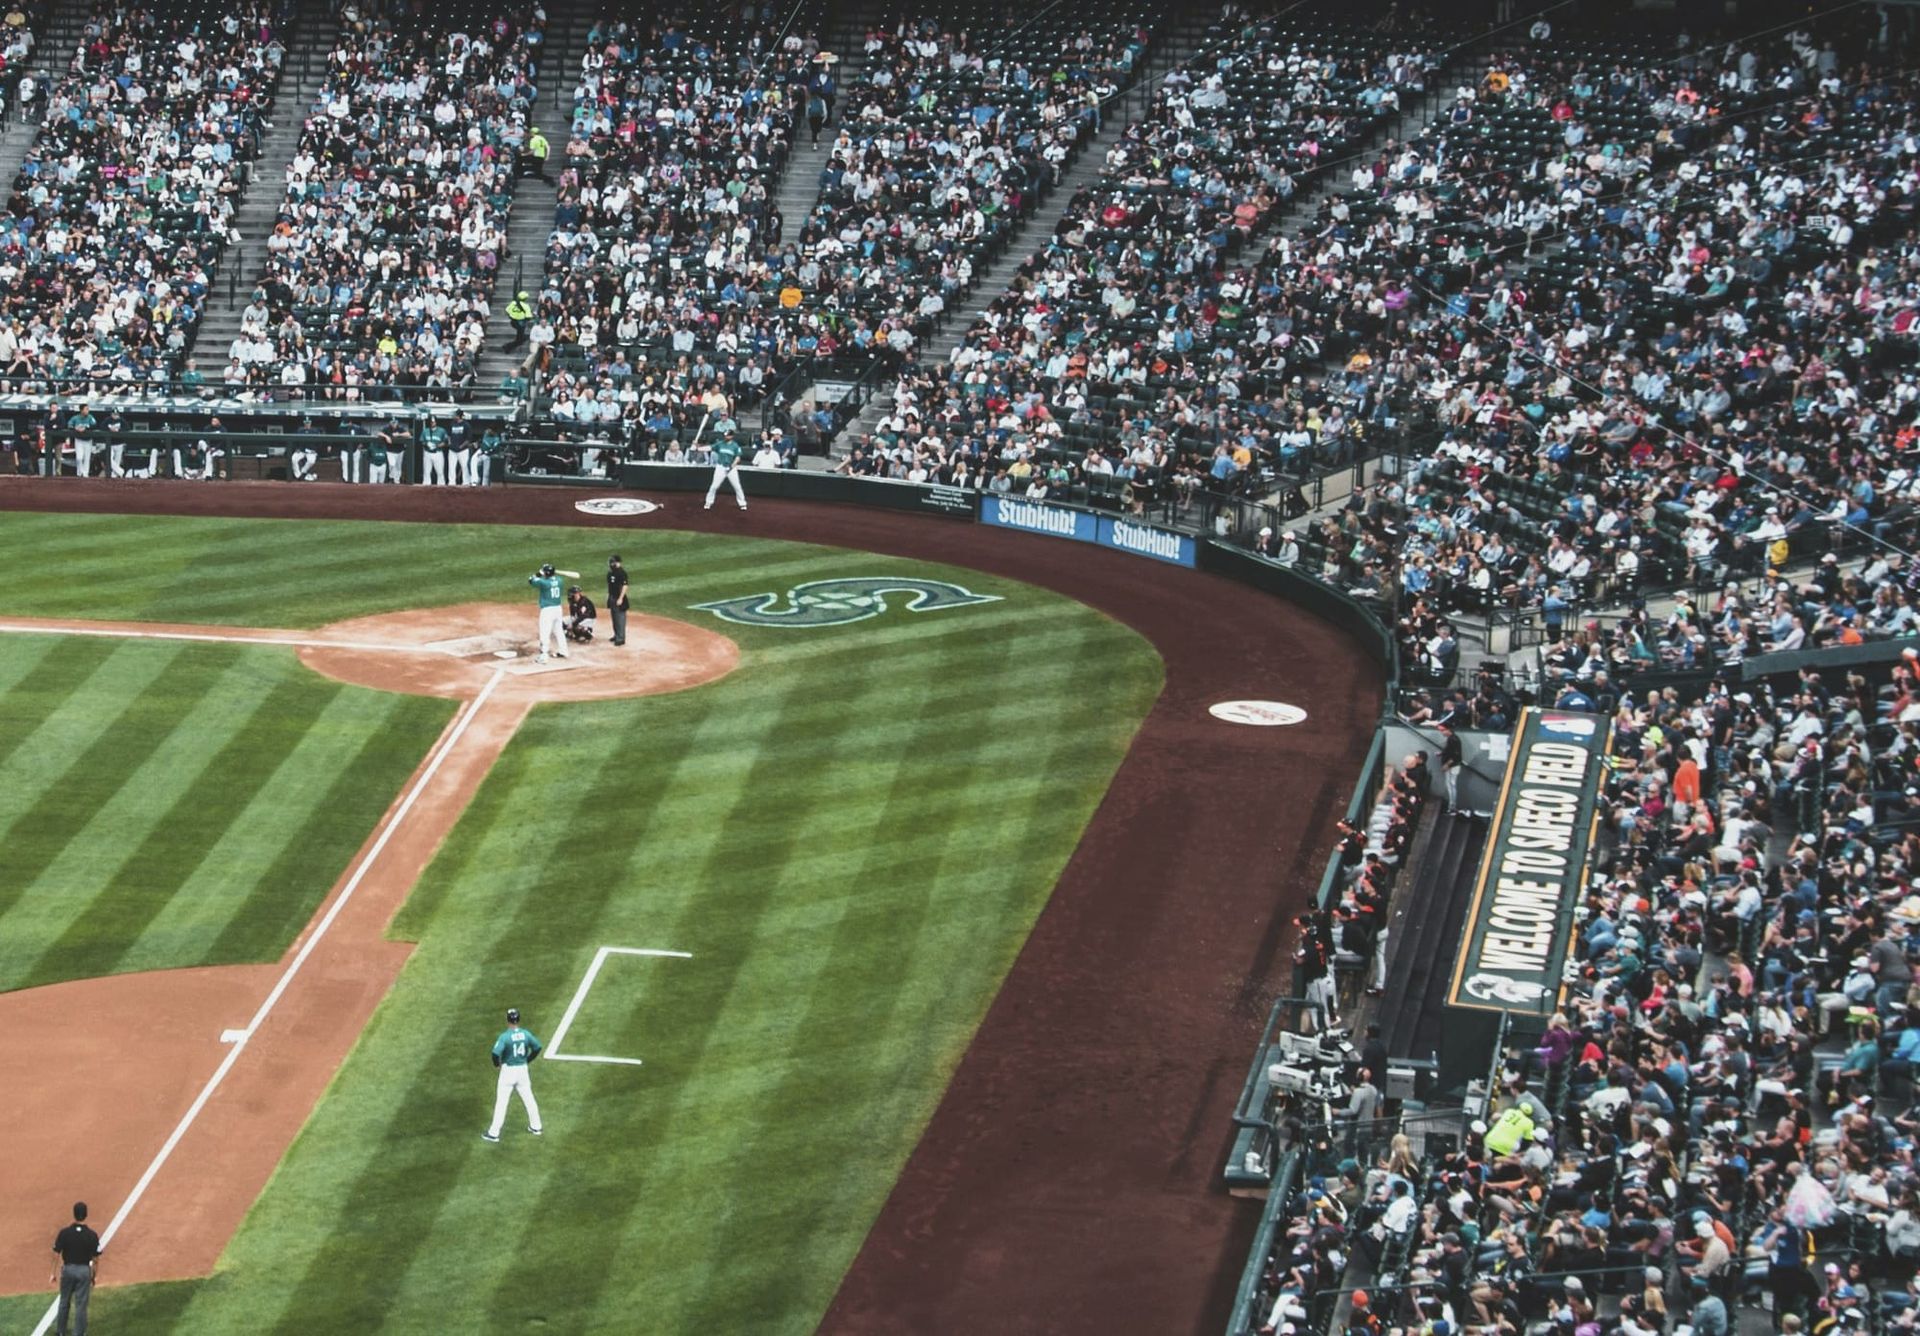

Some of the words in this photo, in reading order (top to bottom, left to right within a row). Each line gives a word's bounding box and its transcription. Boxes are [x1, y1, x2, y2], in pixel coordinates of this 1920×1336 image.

[998, 500, 1075, 535] StubHub!
[1113, 521, 1181, 559] StubHub!
[550, 587, 560, 598] 10
[1523, 742, 1588, 788] FIELD
[1507, 788, 1579, 852] SAFECO
[1501, 850, 1567, 876] TO
[1479, 877, 1561, 971] WELCOME
[513, 1042, 525, 1057] 14
